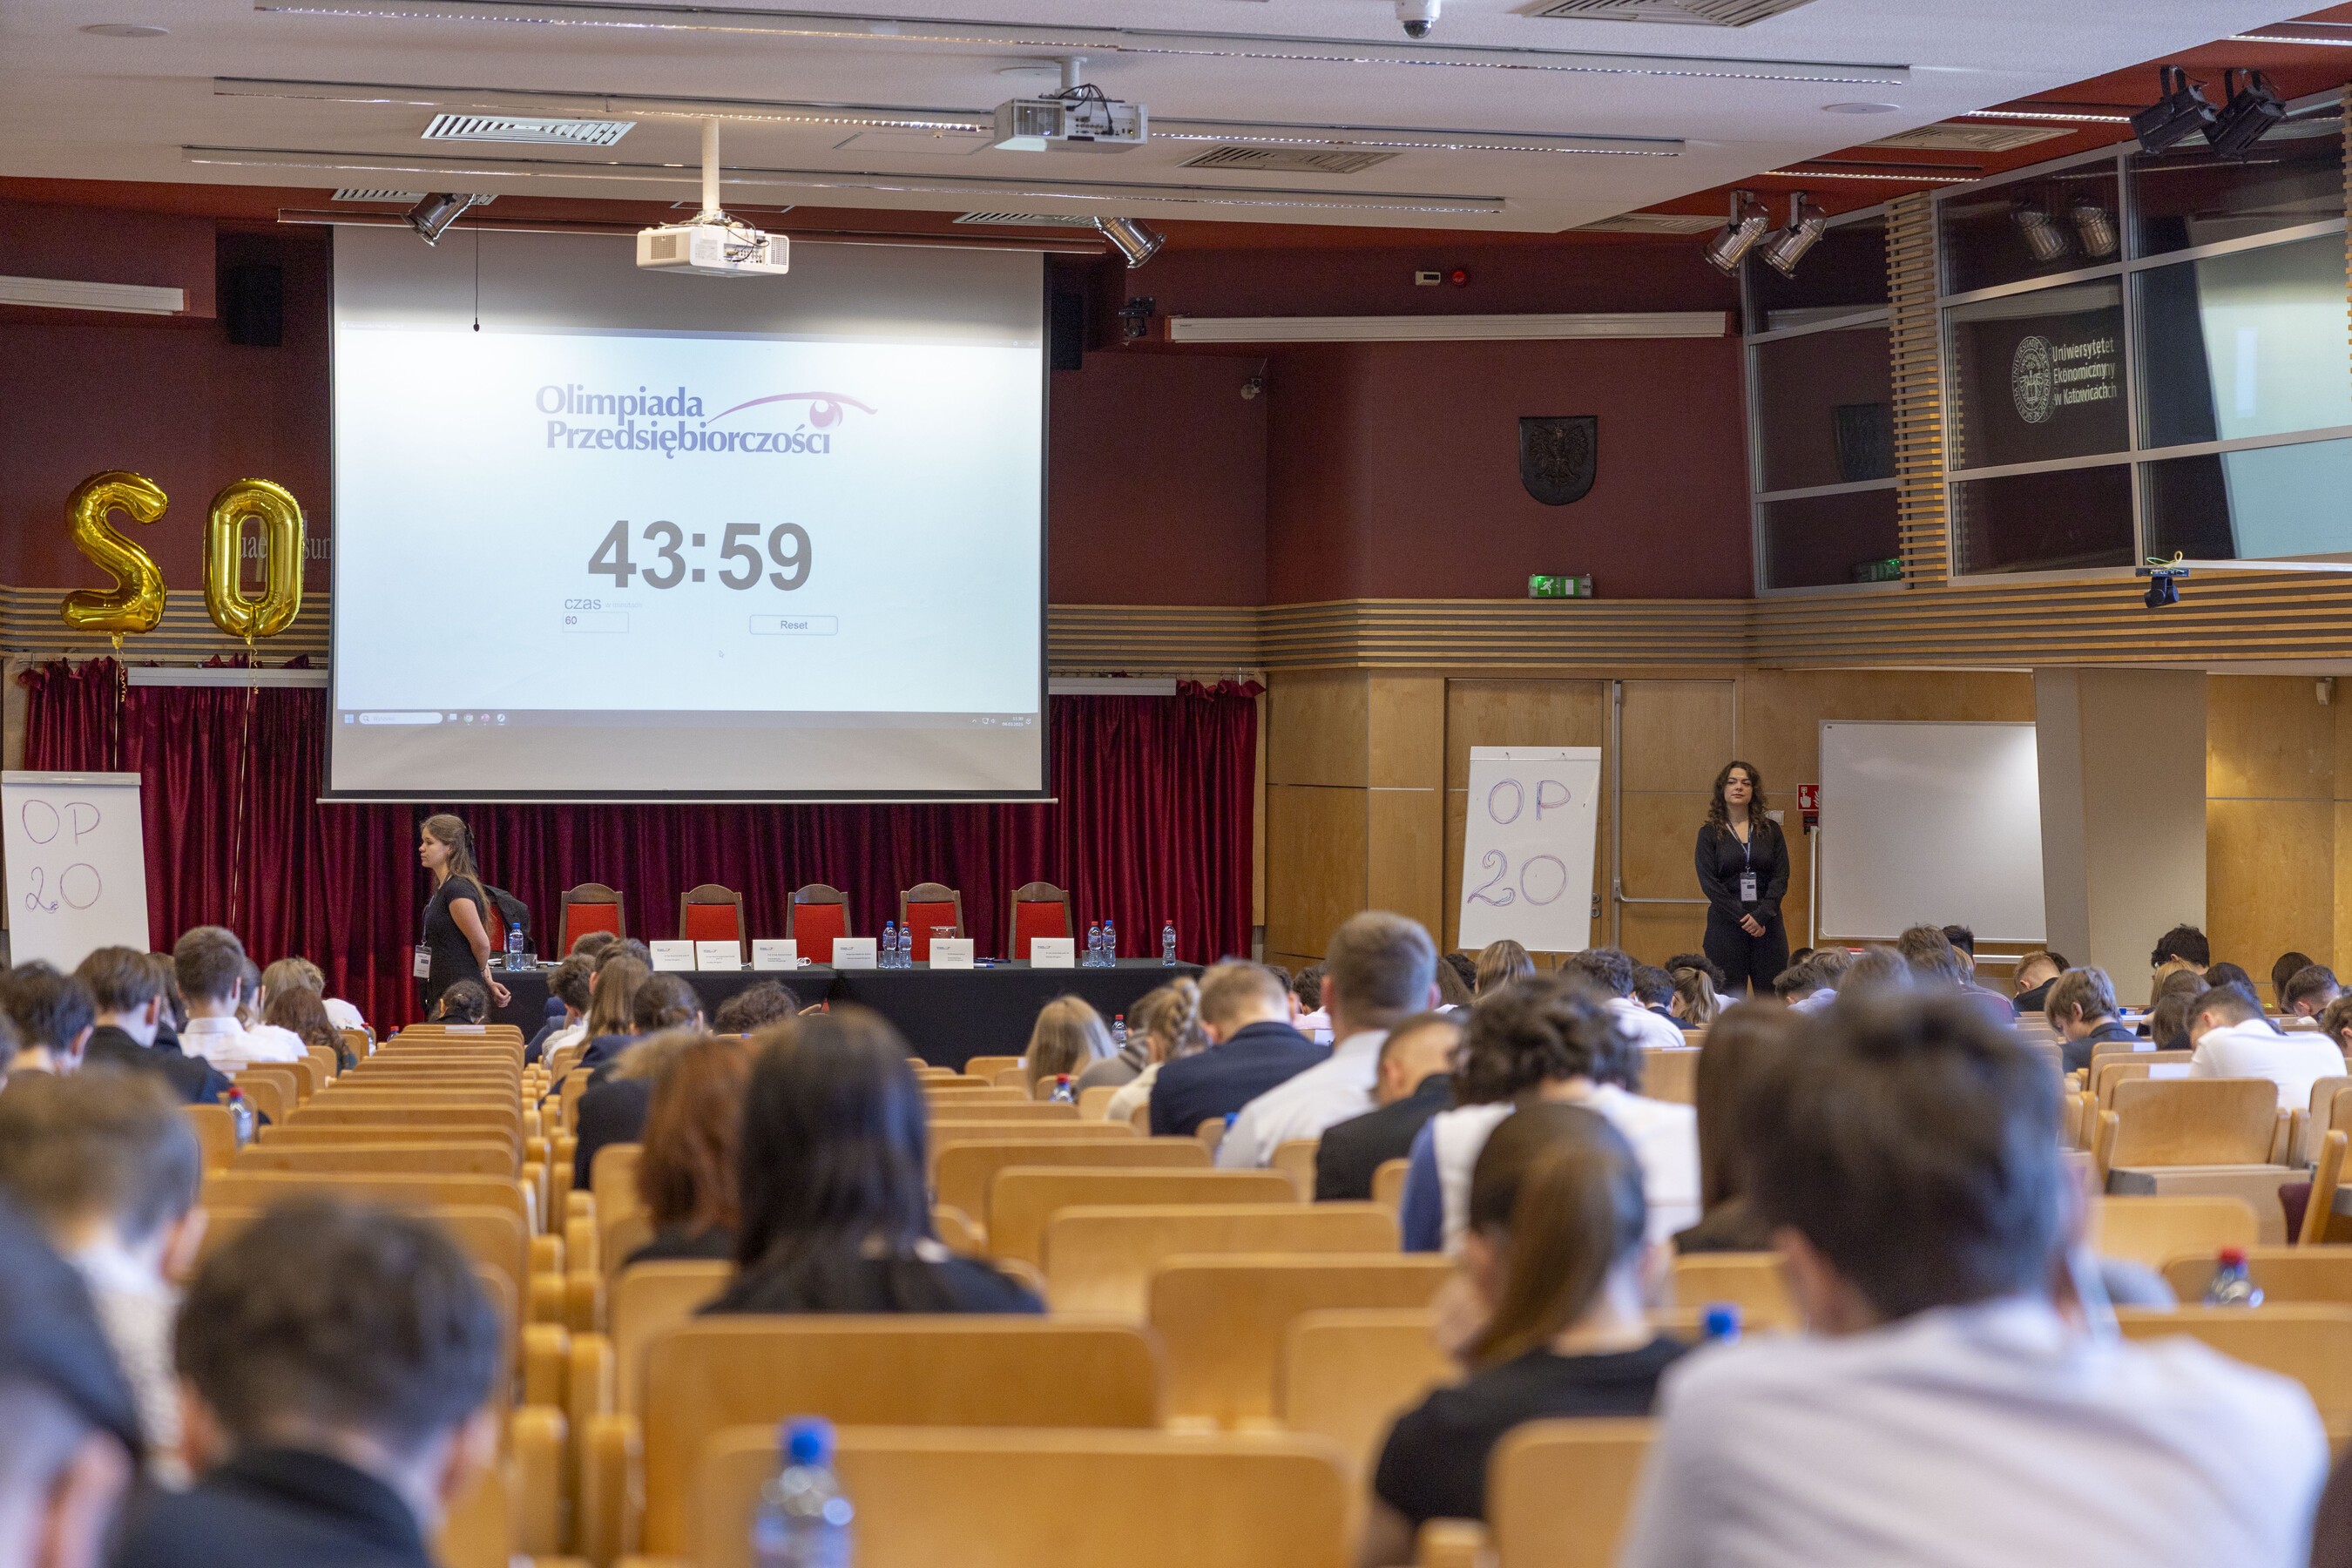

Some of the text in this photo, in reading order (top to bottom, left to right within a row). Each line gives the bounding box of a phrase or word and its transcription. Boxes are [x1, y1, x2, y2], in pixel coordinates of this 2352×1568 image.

[536, 383, 705, 426] Olimpiada
[546, 420, 830, 459] Przedsiębiorczości
[588, 519, 812, 591] 43:59
[564, 598, 602, 610] czas
[564, 615, 578, 625] 60
[780, 620, 808, 630] Reset
[22, 799, 102, 846] OP
[1488, 778, 1571, 825] OP
[1466, 848, 1569, 907] 20
